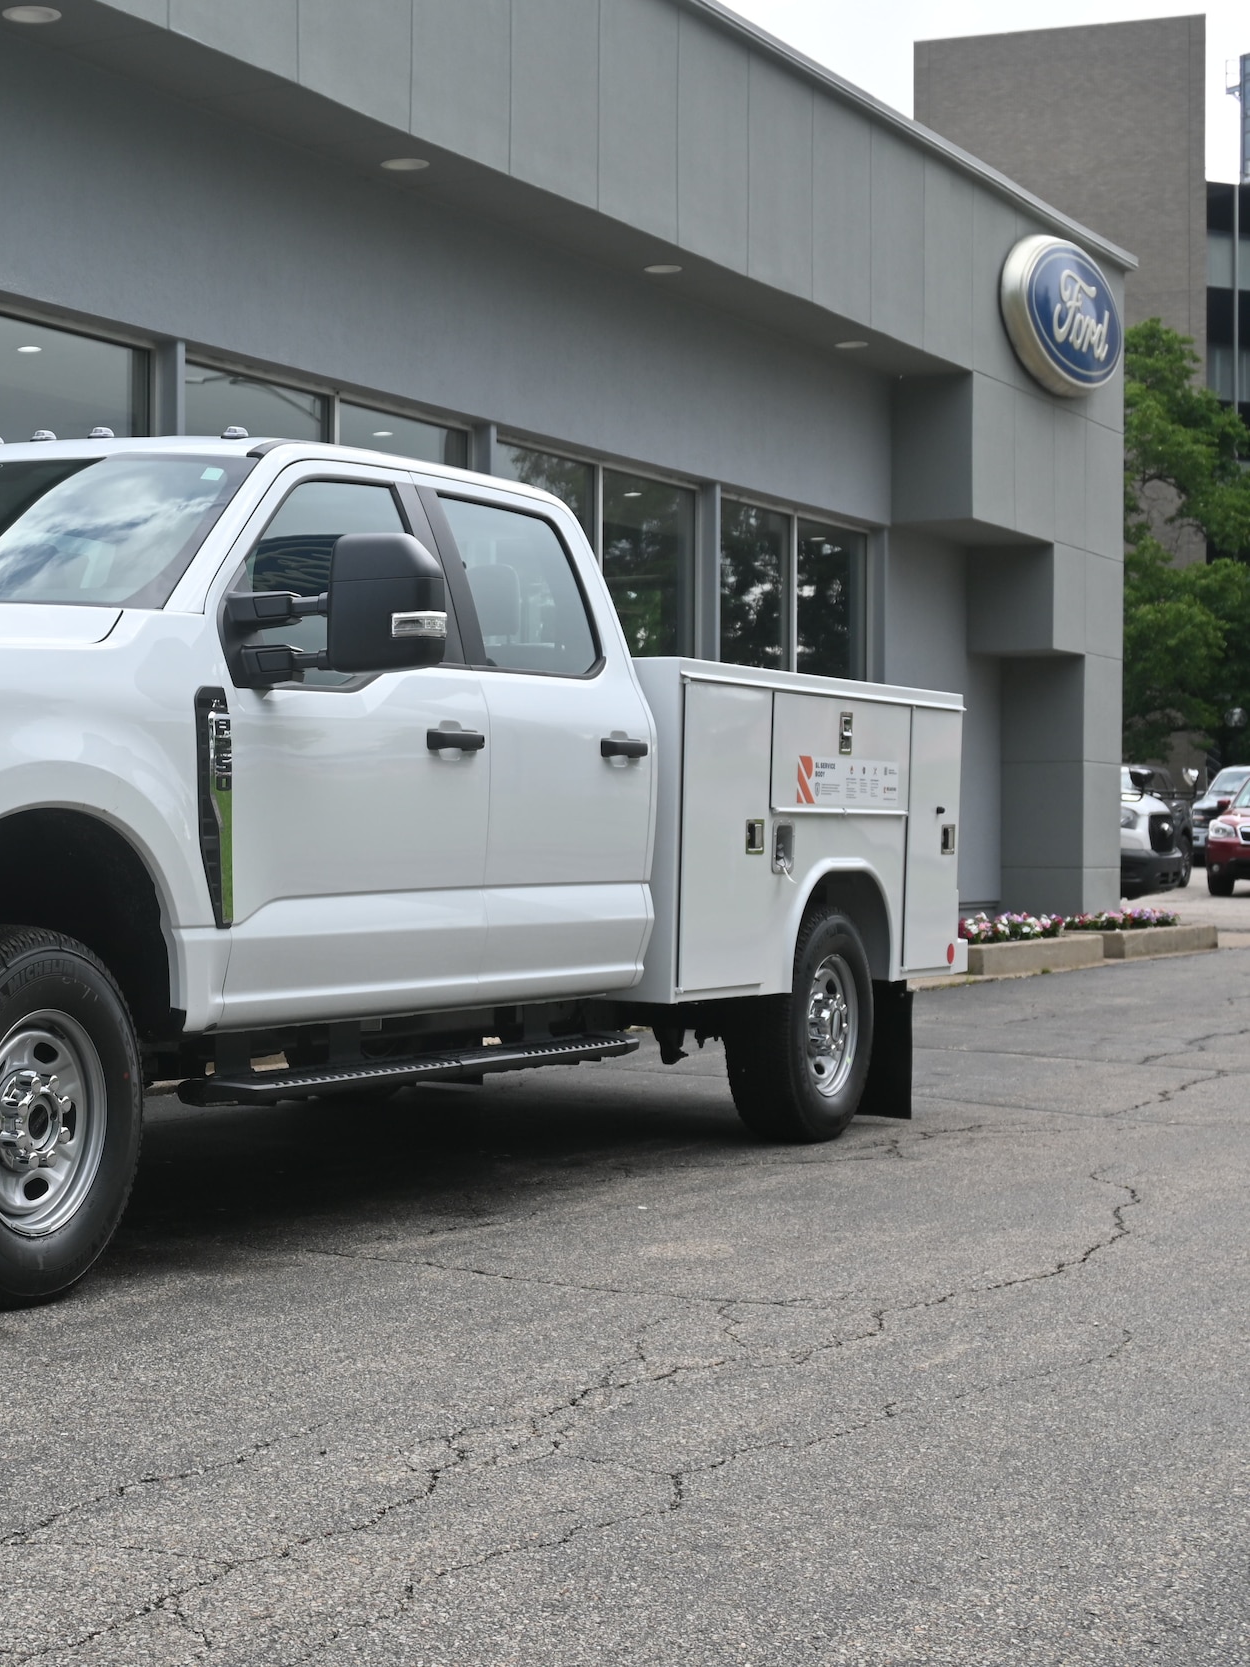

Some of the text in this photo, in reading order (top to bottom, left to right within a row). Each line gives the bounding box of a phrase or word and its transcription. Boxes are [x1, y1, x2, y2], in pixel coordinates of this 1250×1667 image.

[1053, 269, 1110, 362] Ford
[820, 762, 836, 770] SERVICE
[7, 959, 76, 998] MICHELIN
